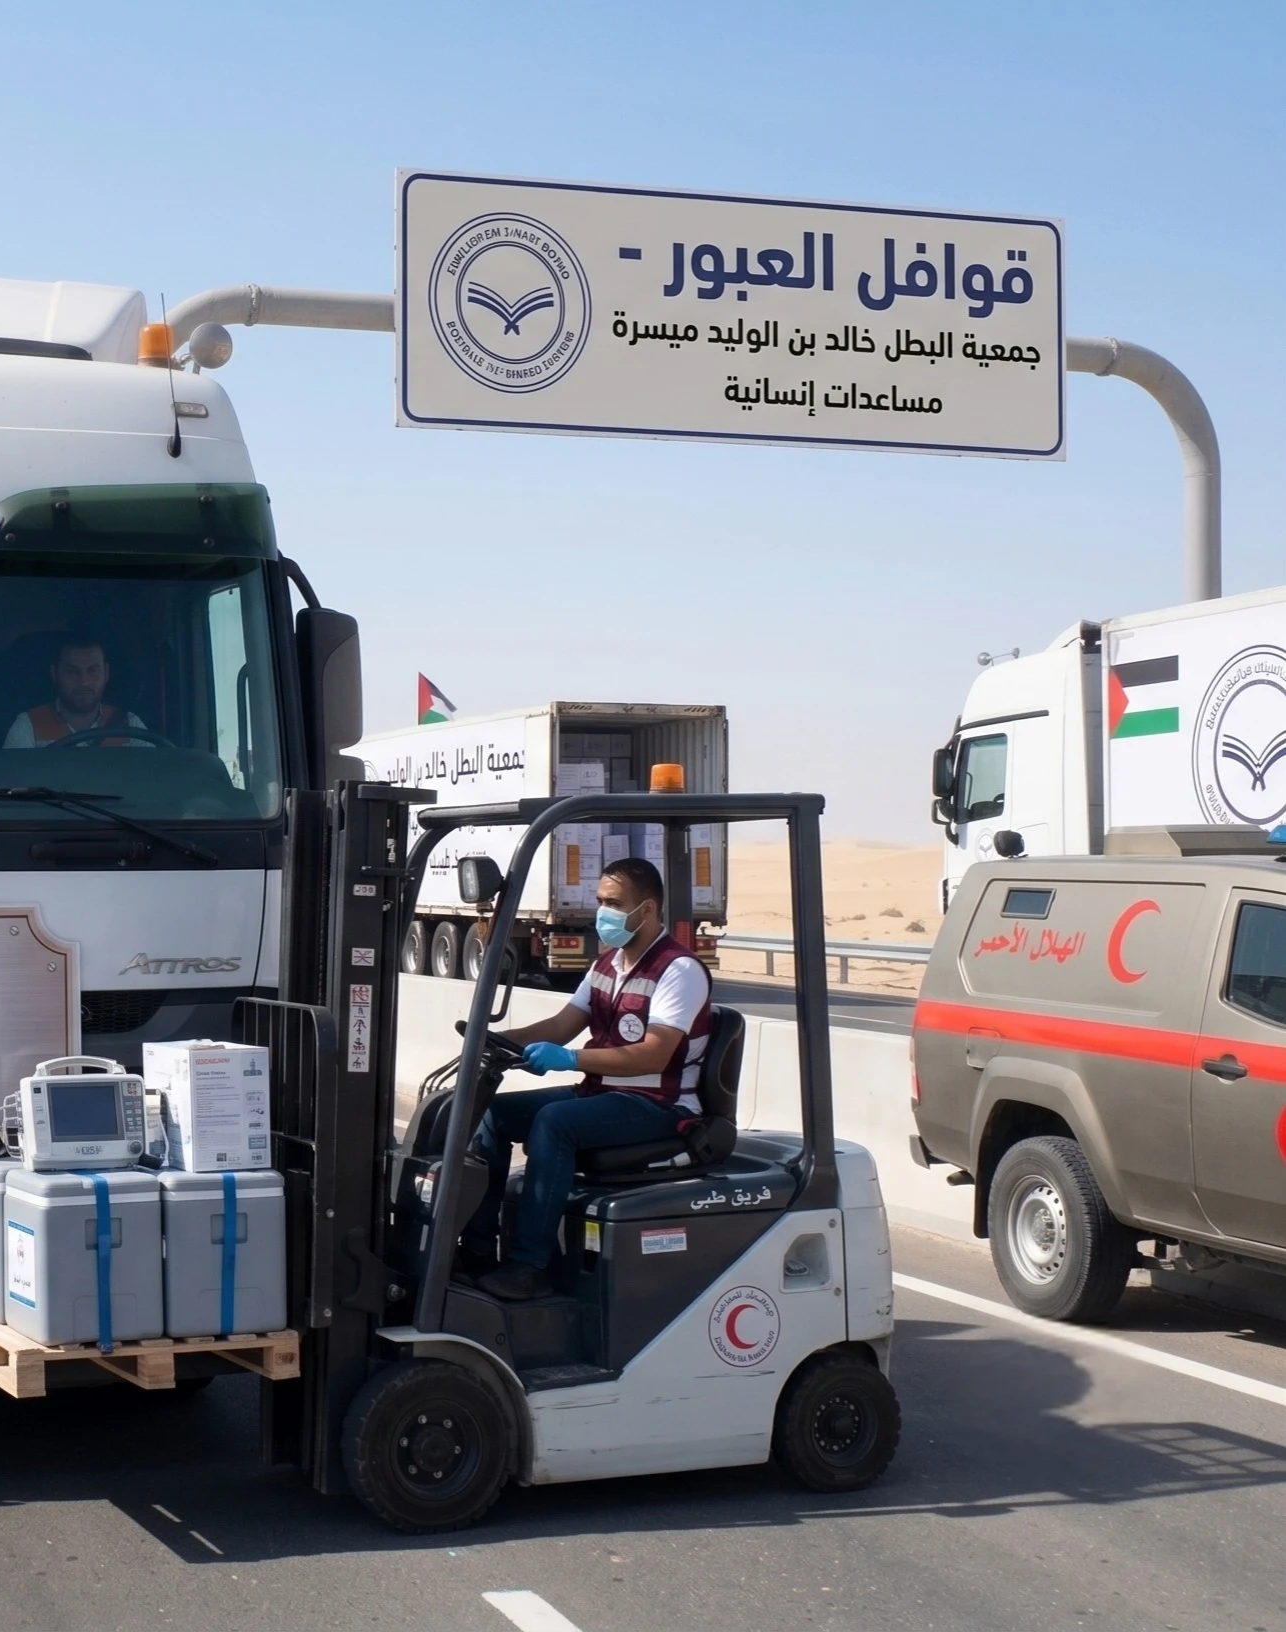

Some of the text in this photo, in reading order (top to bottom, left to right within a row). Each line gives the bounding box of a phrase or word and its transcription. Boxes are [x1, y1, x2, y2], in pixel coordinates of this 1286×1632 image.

[664, 231, 834, 302] العبور
[857, 238, 1034, 319] قوافل
[612, 311, 1041, 371] جمعية البطل خالد بن الوليد ميسرة
[724, 375, 944, 417] مساعدات إنسانية
[425, 751, 447, 780] خالد
[731, 1185, 772, 1206] فريق
